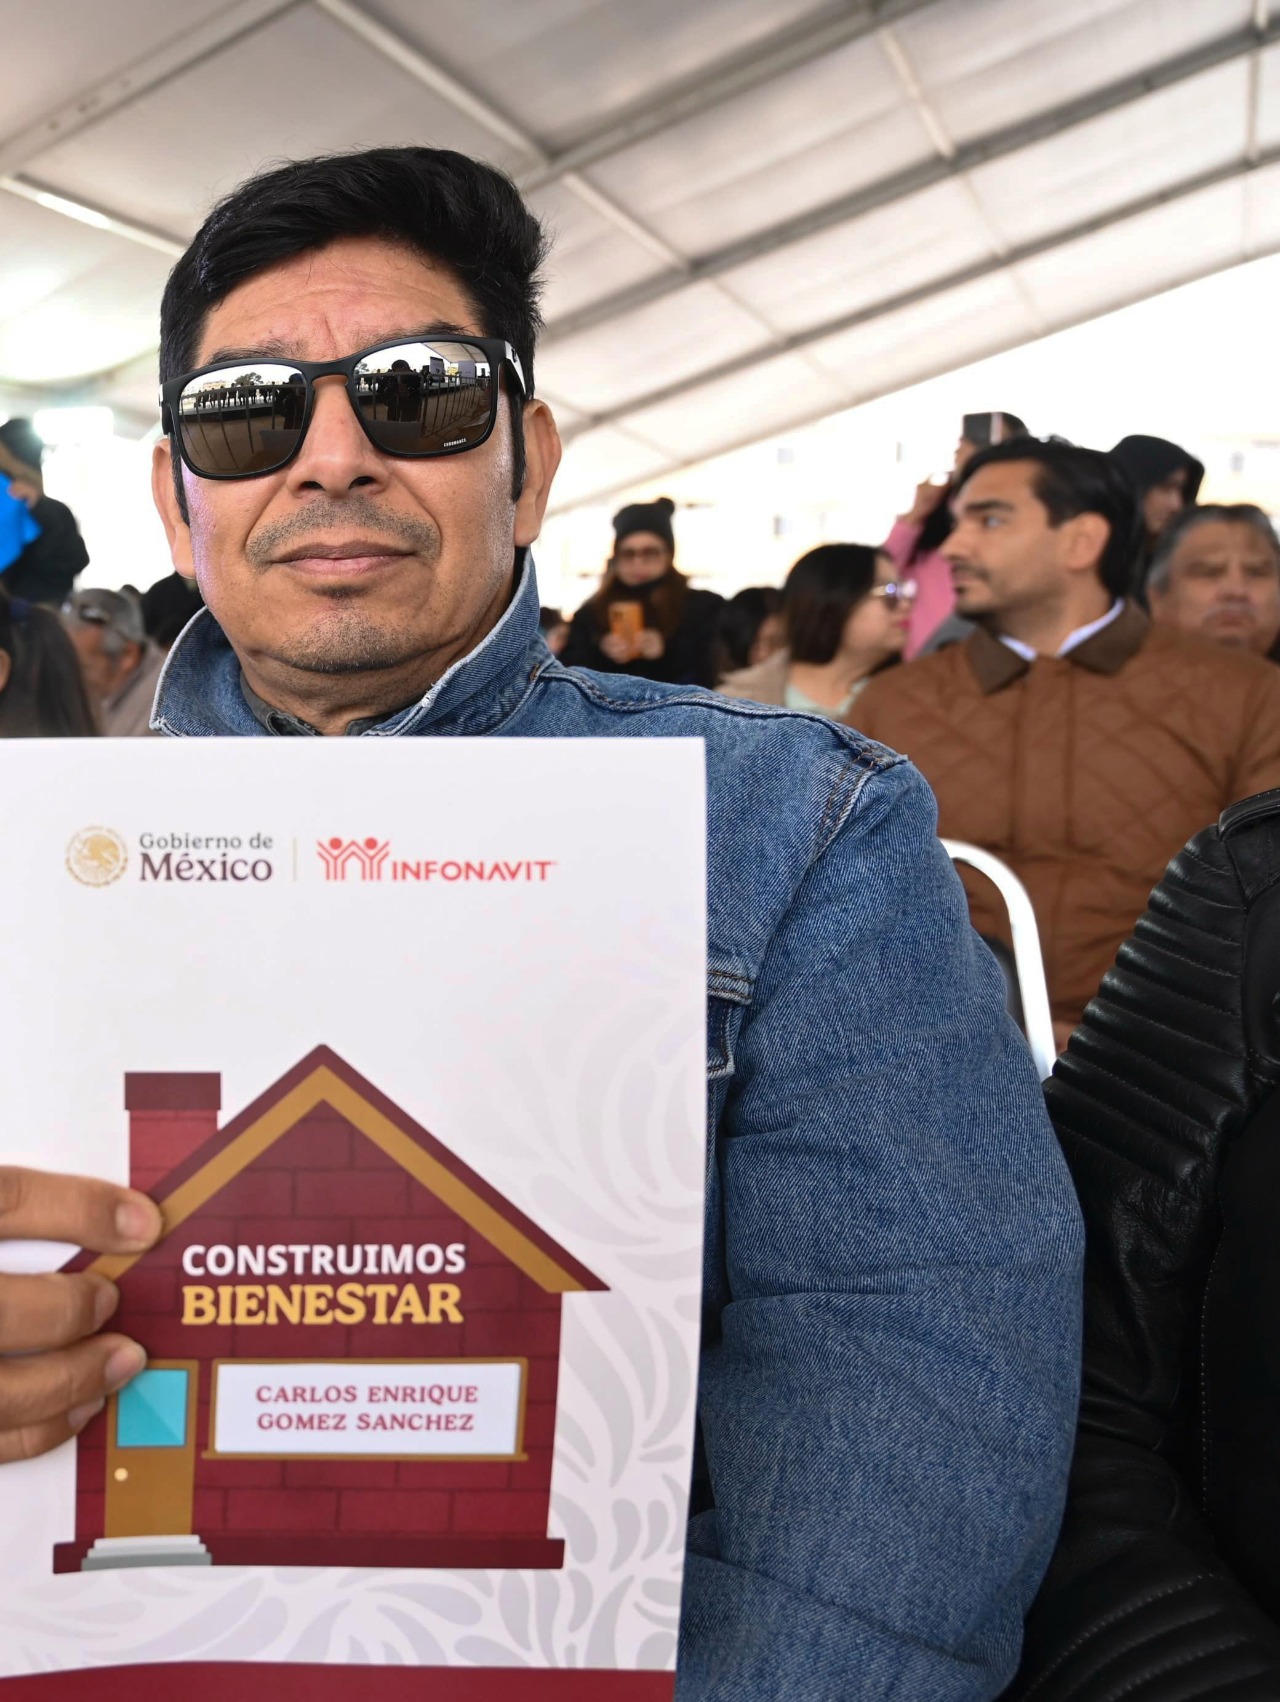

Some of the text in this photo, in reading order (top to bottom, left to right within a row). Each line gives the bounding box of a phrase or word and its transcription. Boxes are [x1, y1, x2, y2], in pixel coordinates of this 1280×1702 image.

[139, 832, 274, 850] Gobierno de
[138, 850, 274, 882] México
[392, 860, 558, 882] INFONAVIT
[182, 1243, 466, 1276] CONSTRUIMOS
[181, 1283, 464, 1326] BIENESTAR
[255, 1384, 478, 1405] CARLOS ENRIQUE
[256, 1412, 474, 1431] GOMEZ SANCHEZ
